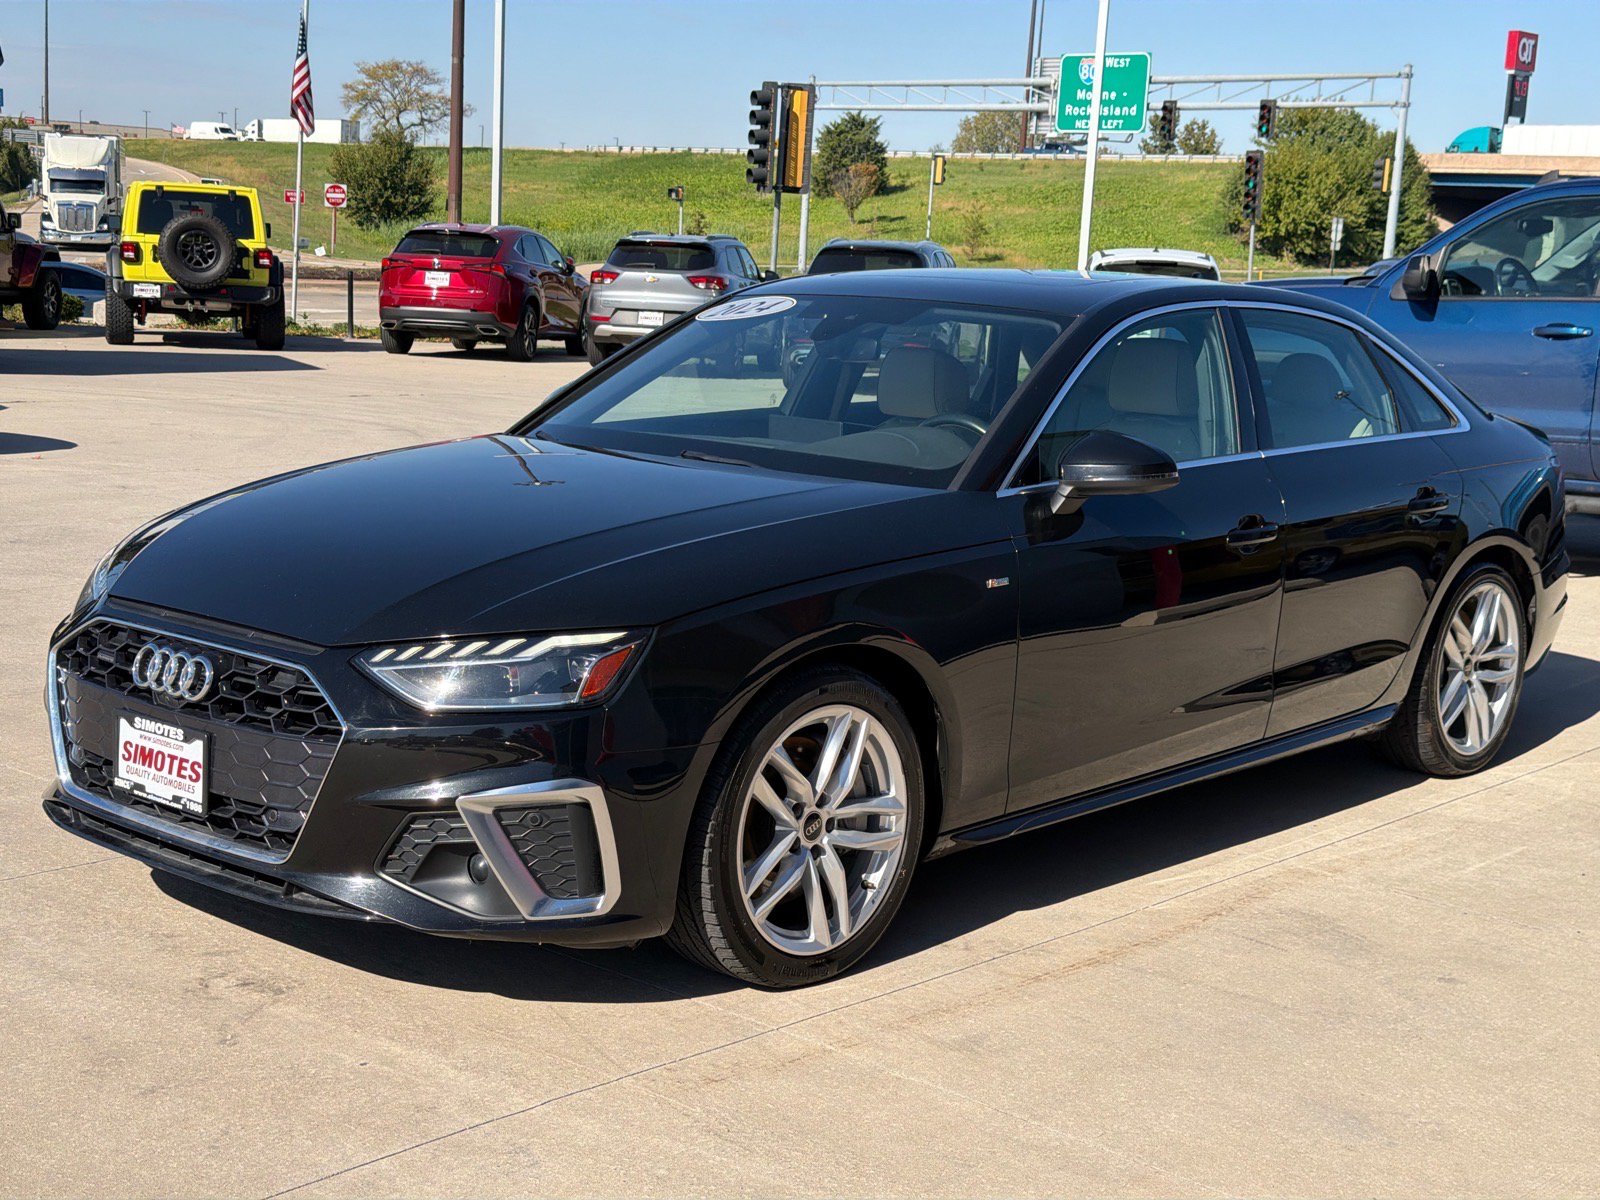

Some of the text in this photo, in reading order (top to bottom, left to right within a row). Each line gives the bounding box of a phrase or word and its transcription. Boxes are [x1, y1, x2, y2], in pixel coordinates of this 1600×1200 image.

[1518, 38, 1535, 64] QT
[1105, 57, 1130, 68] WEST
[1077, 89, 1117, 100] Mone
[1102, 120, 1123, 128] LEFT
[133, 716, 184, 741] SIMOTES
[139, 734, 184, 752] www.simotes.com
[122, 740, 202, 783] SIMOTES
[126, 764, 196, 795] QUALITY AUTOMOBILES
